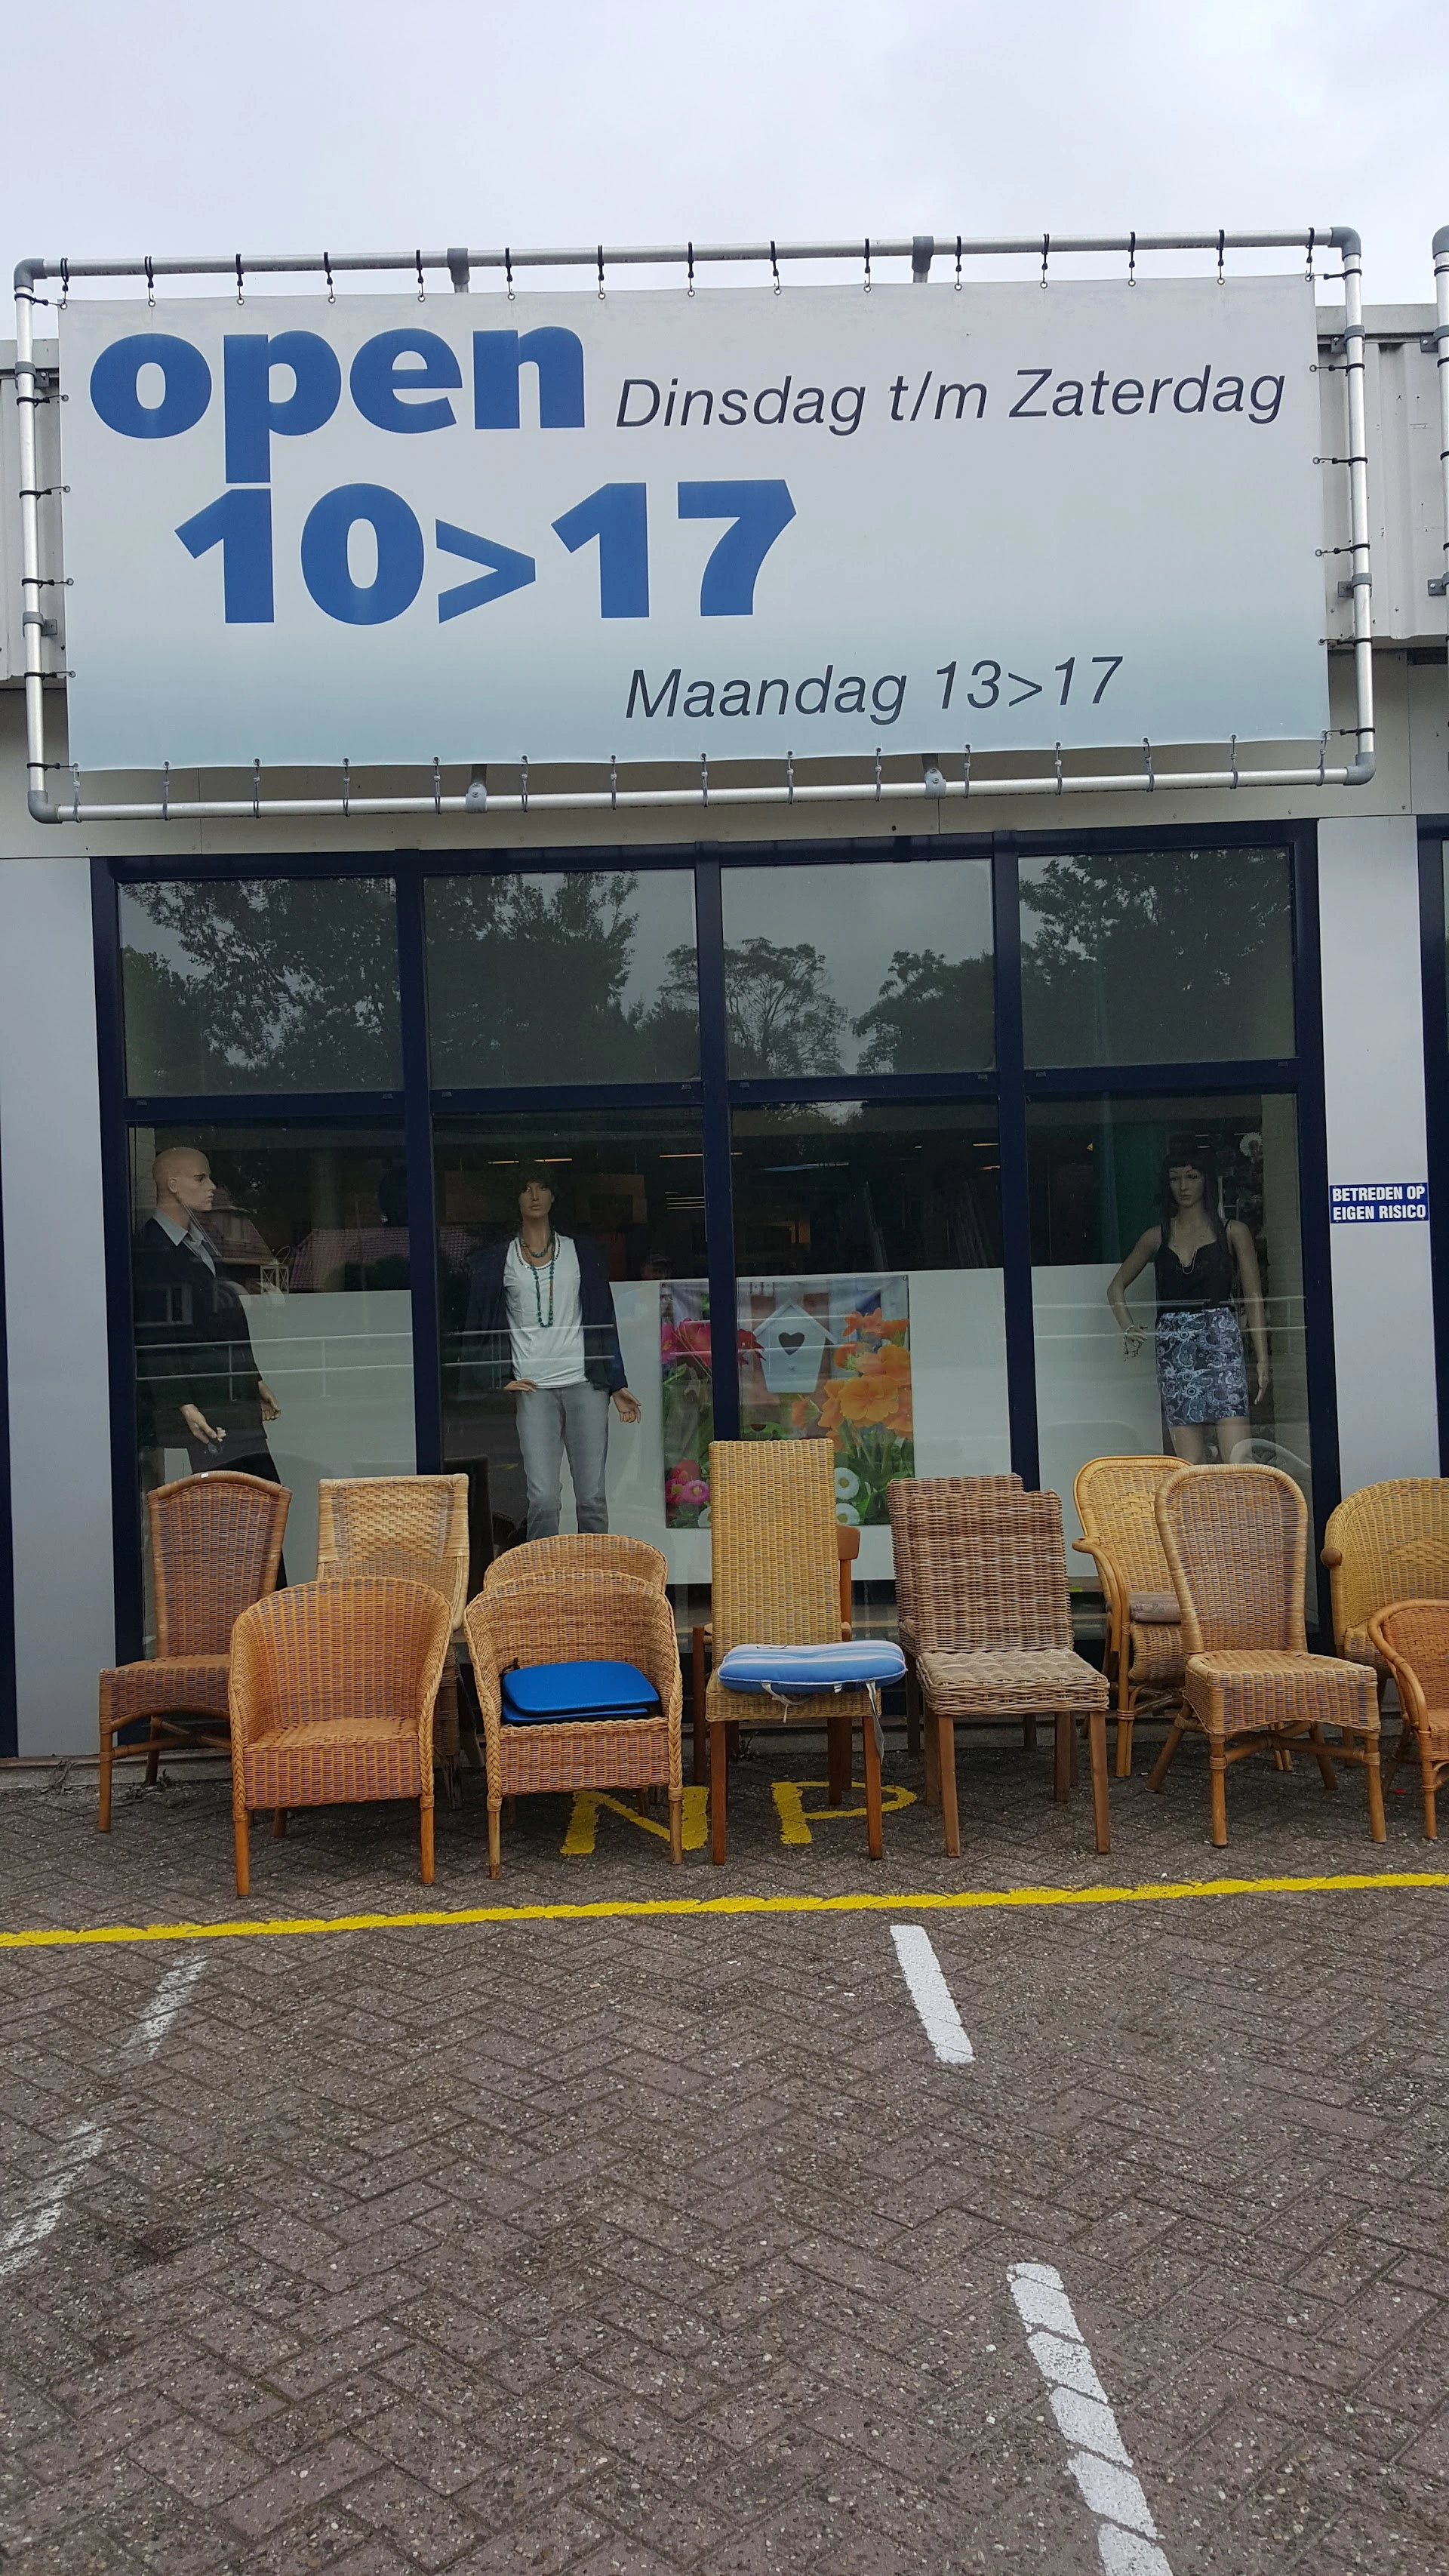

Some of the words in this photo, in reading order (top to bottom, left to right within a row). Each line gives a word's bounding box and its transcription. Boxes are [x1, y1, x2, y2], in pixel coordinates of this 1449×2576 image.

[91, 327, 584, 484] open
[617, 376, 866, 436] Dinsdag
[889, 371, 987, 421] t/m
[1009, 365, 1285, 424] Zaterdag
[174, 480, 796, 626] 10>17
[626, 665, 907, 725] Maandag
[936, 657, 1124, 709] 13>17
[1332, 1186, 1403, 1202] BETREDEN
[1406, 1186, 1426, 1199] OP
[1333, 1206, 1375, 1220] EIGEN
[1379, 1205, 1426, 1219] RISICO
